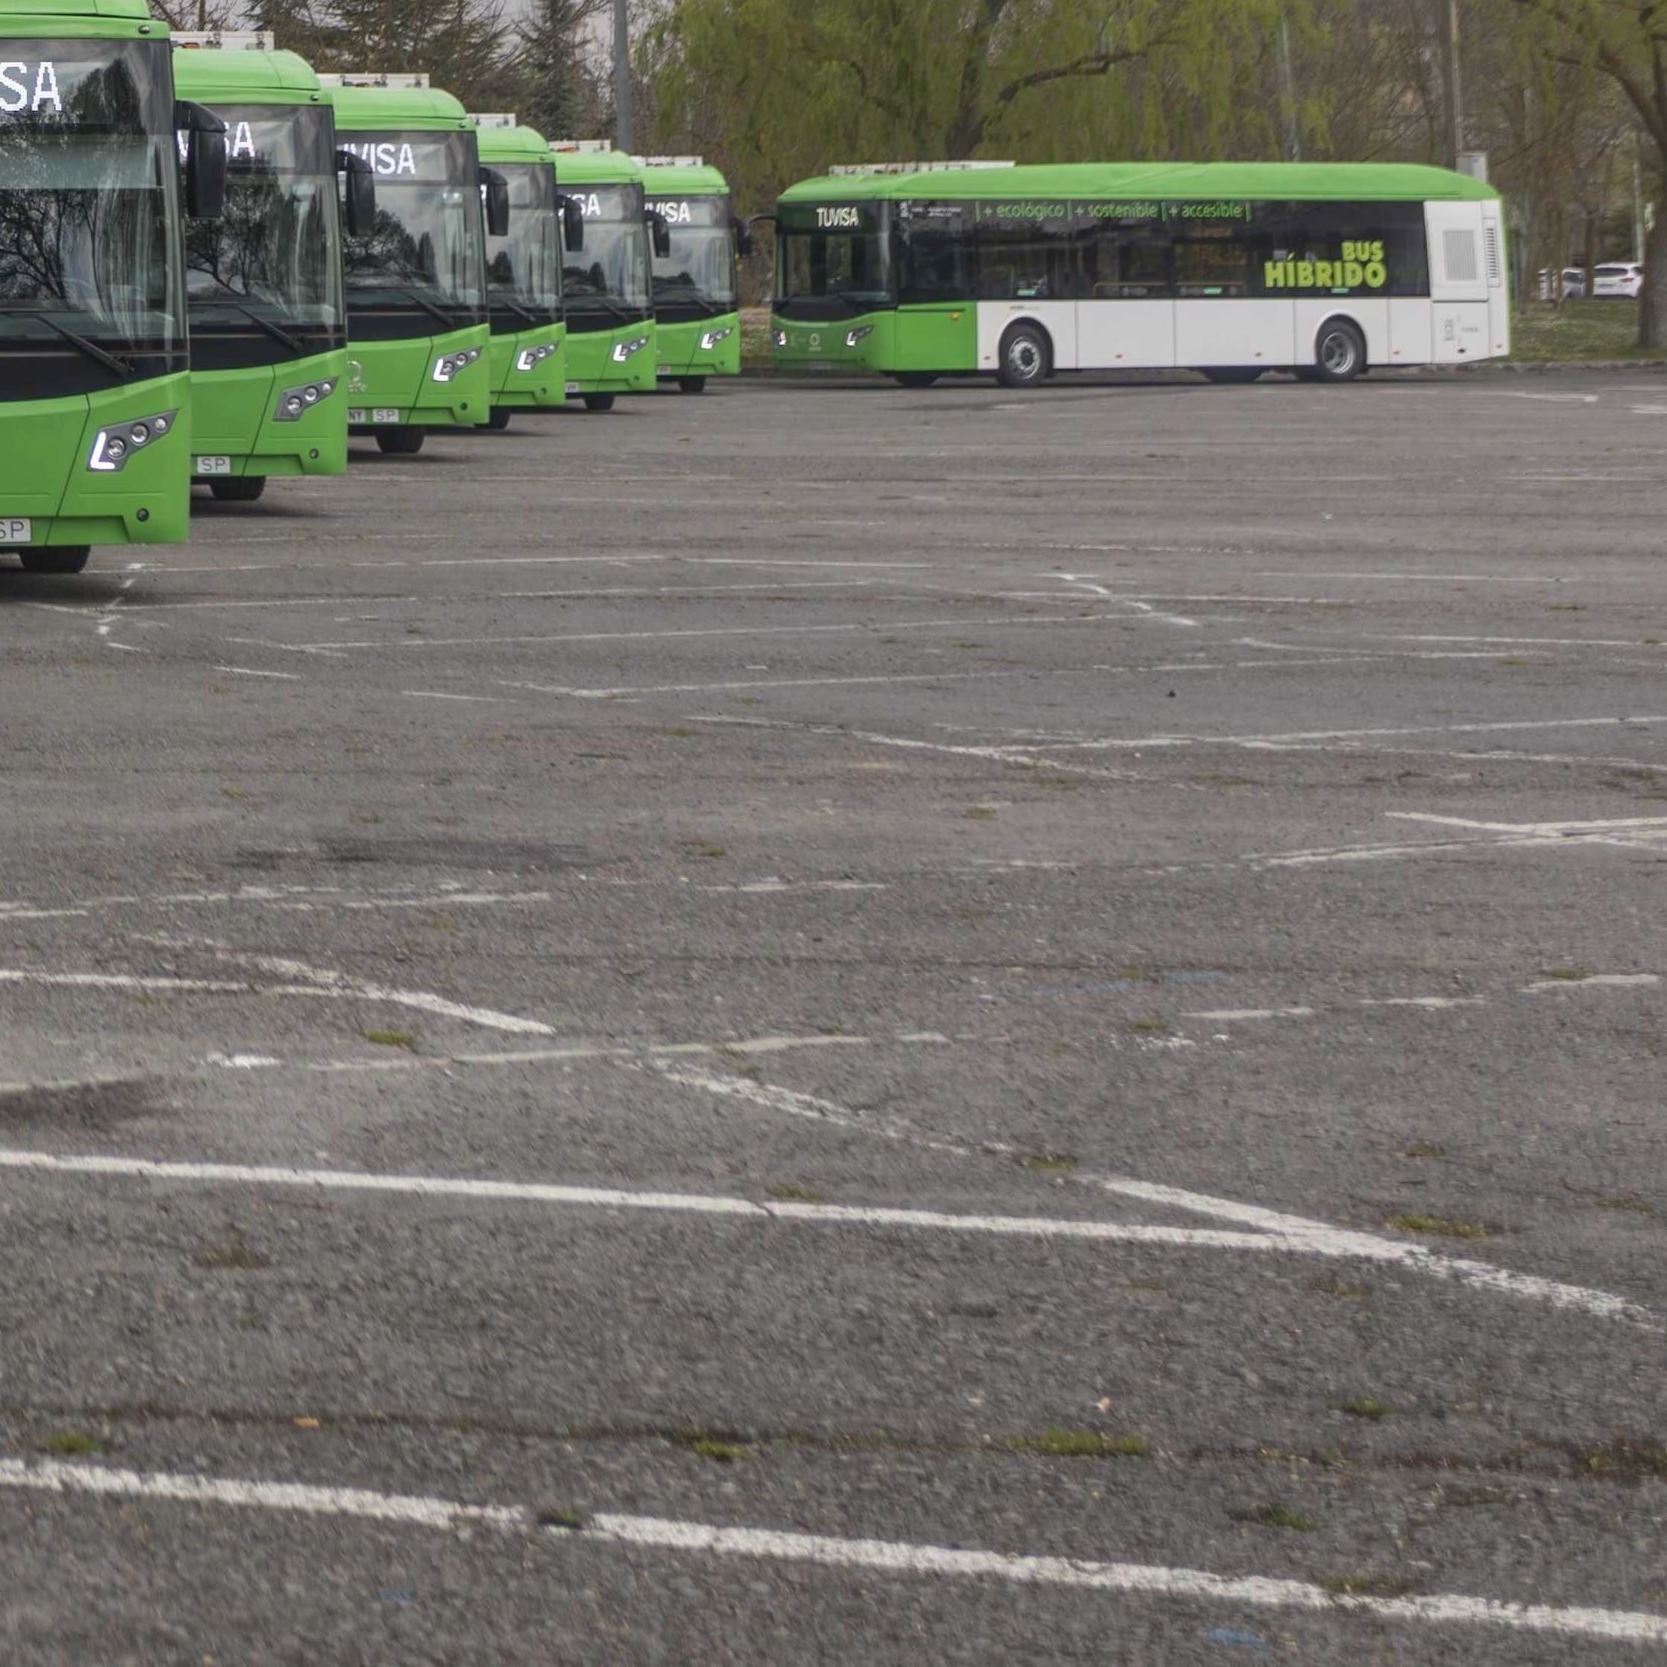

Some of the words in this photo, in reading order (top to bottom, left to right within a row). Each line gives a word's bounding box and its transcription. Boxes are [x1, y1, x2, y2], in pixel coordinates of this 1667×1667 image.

[816, 206, 860, 227] TUVISA
[996, 201, 1065, 221] ecológico
[1087, 201, 1158, 218] sostenible
[1181, 201, 1244, 218] accesible
[1341, 240, 1384, 262] BUS
[1264, 251, 1388, 288] HÍBRIDO
[375, 409, 396, 422] SP
[201, 457, 226, 472] SP
